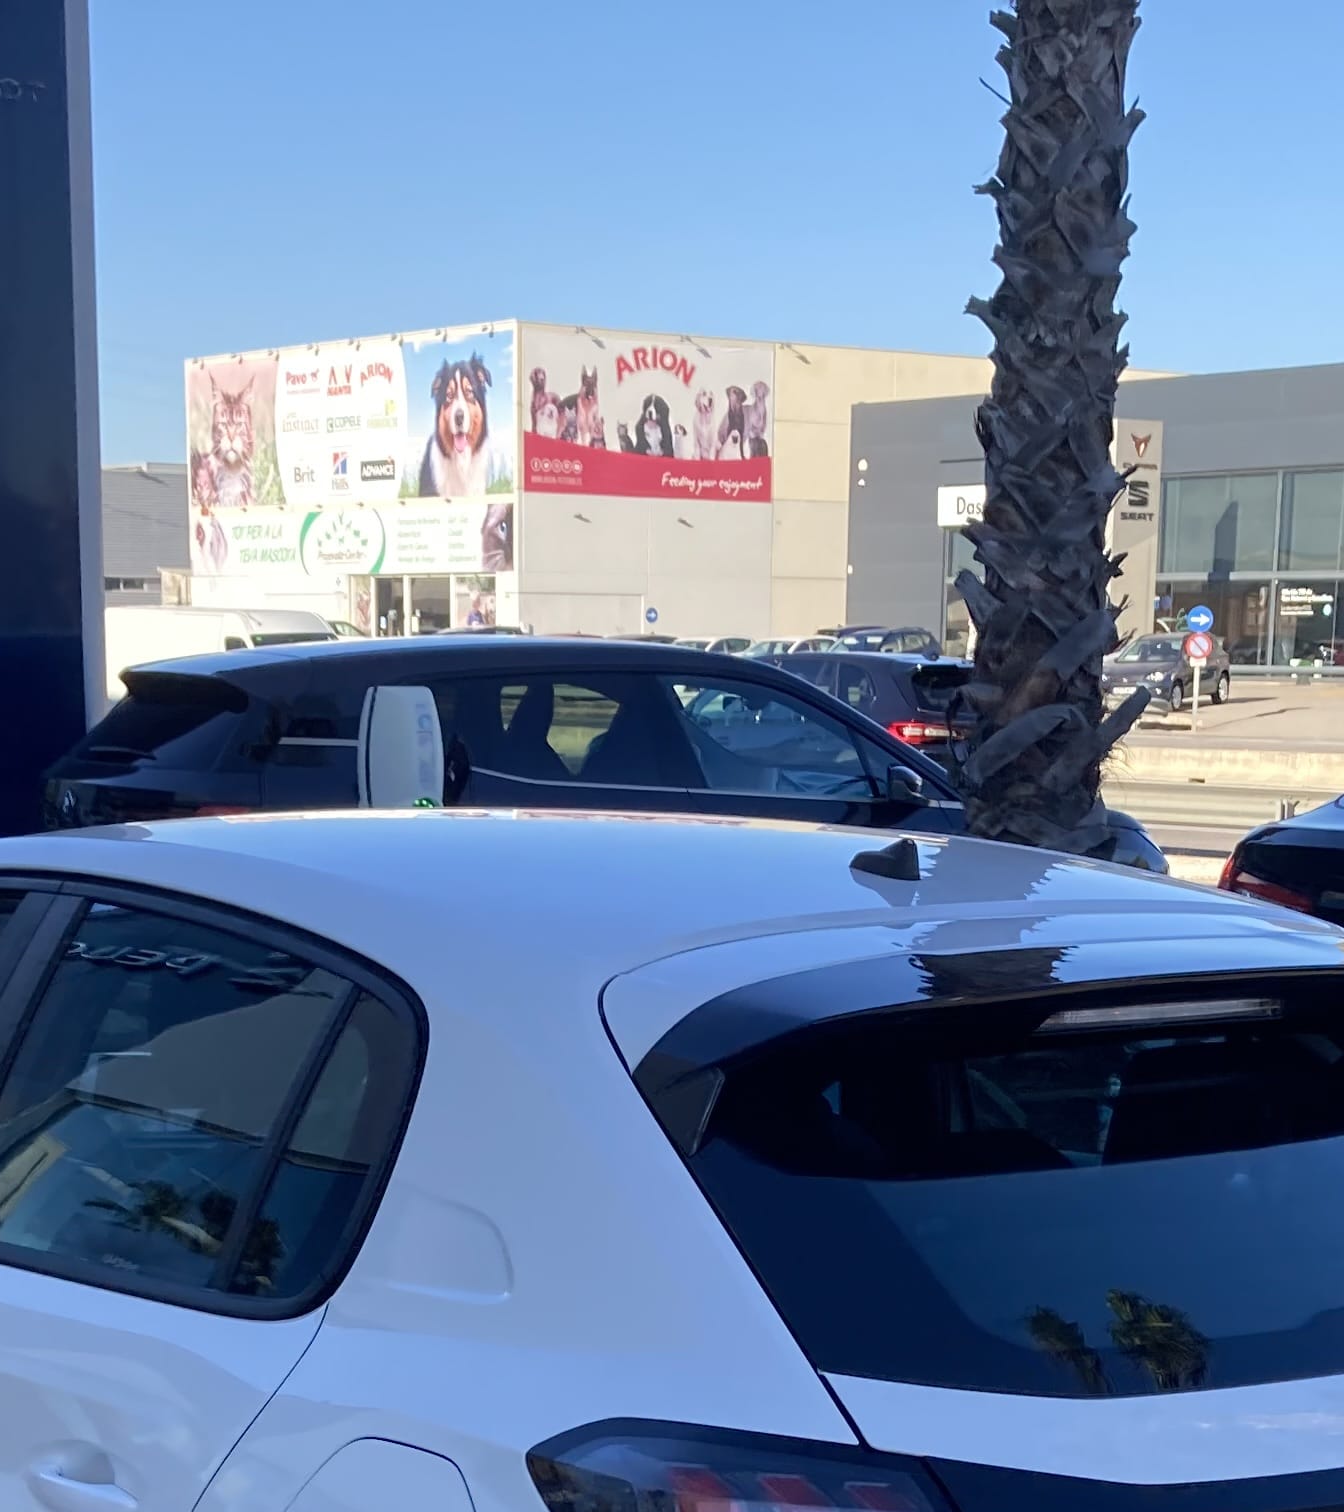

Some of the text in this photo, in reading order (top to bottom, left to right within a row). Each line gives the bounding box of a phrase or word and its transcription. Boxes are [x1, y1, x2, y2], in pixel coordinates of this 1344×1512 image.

[360, 362, 394, 387] ARION
[615, 345, 696, 388] ARION
[294, 466, 315, 483] Brit
[361, 463, 395, 477] ADVANCE
[661, 472, 696, 492] Feeding
[697, 480, 717, 495] your
[1120, 511, 1155, 521] SEAT
